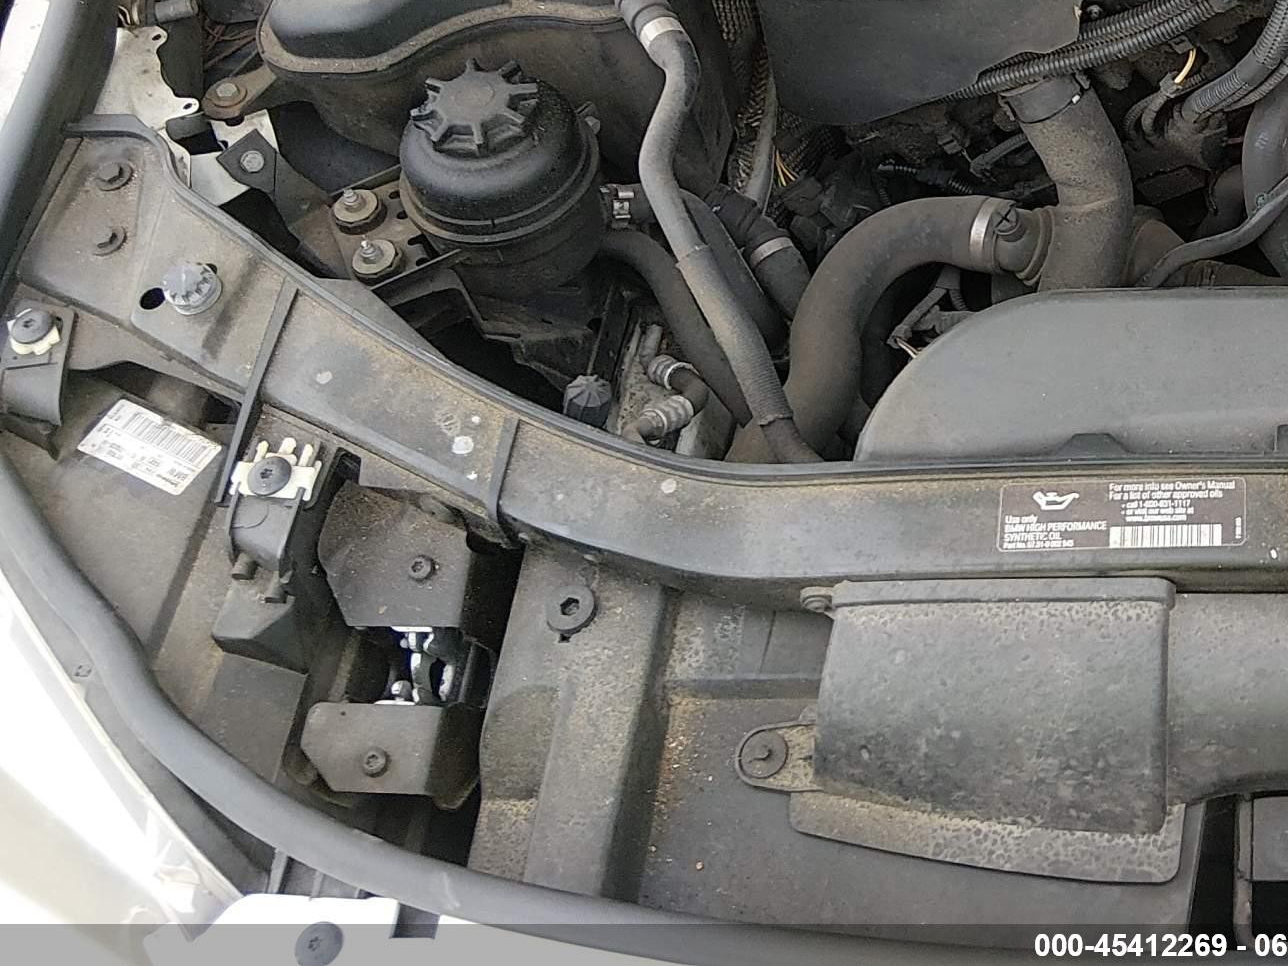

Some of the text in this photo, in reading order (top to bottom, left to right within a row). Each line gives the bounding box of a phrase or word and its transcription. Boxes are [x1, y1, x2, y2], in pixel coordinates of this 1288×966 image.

[1109, 483, 1122, 492] For
[1161, 483, 1174, 491] see
[1175, 481, 1206, 491] Owner's
[1207, 480, 1235, 490] Manual
[1109, 491, 1122, 500] For
[1142, 490, 1150, 499] of
[1172, 489, 1209, 500] approved
[1210, 490, 1223, 498] oils
[1004, 514, 1039, 524] Use only
[1004, 521, 1107, 532] BMW HIGH PERFORMANCE
[1004, 531, 1062, 542] SYNTHETIC OIL
